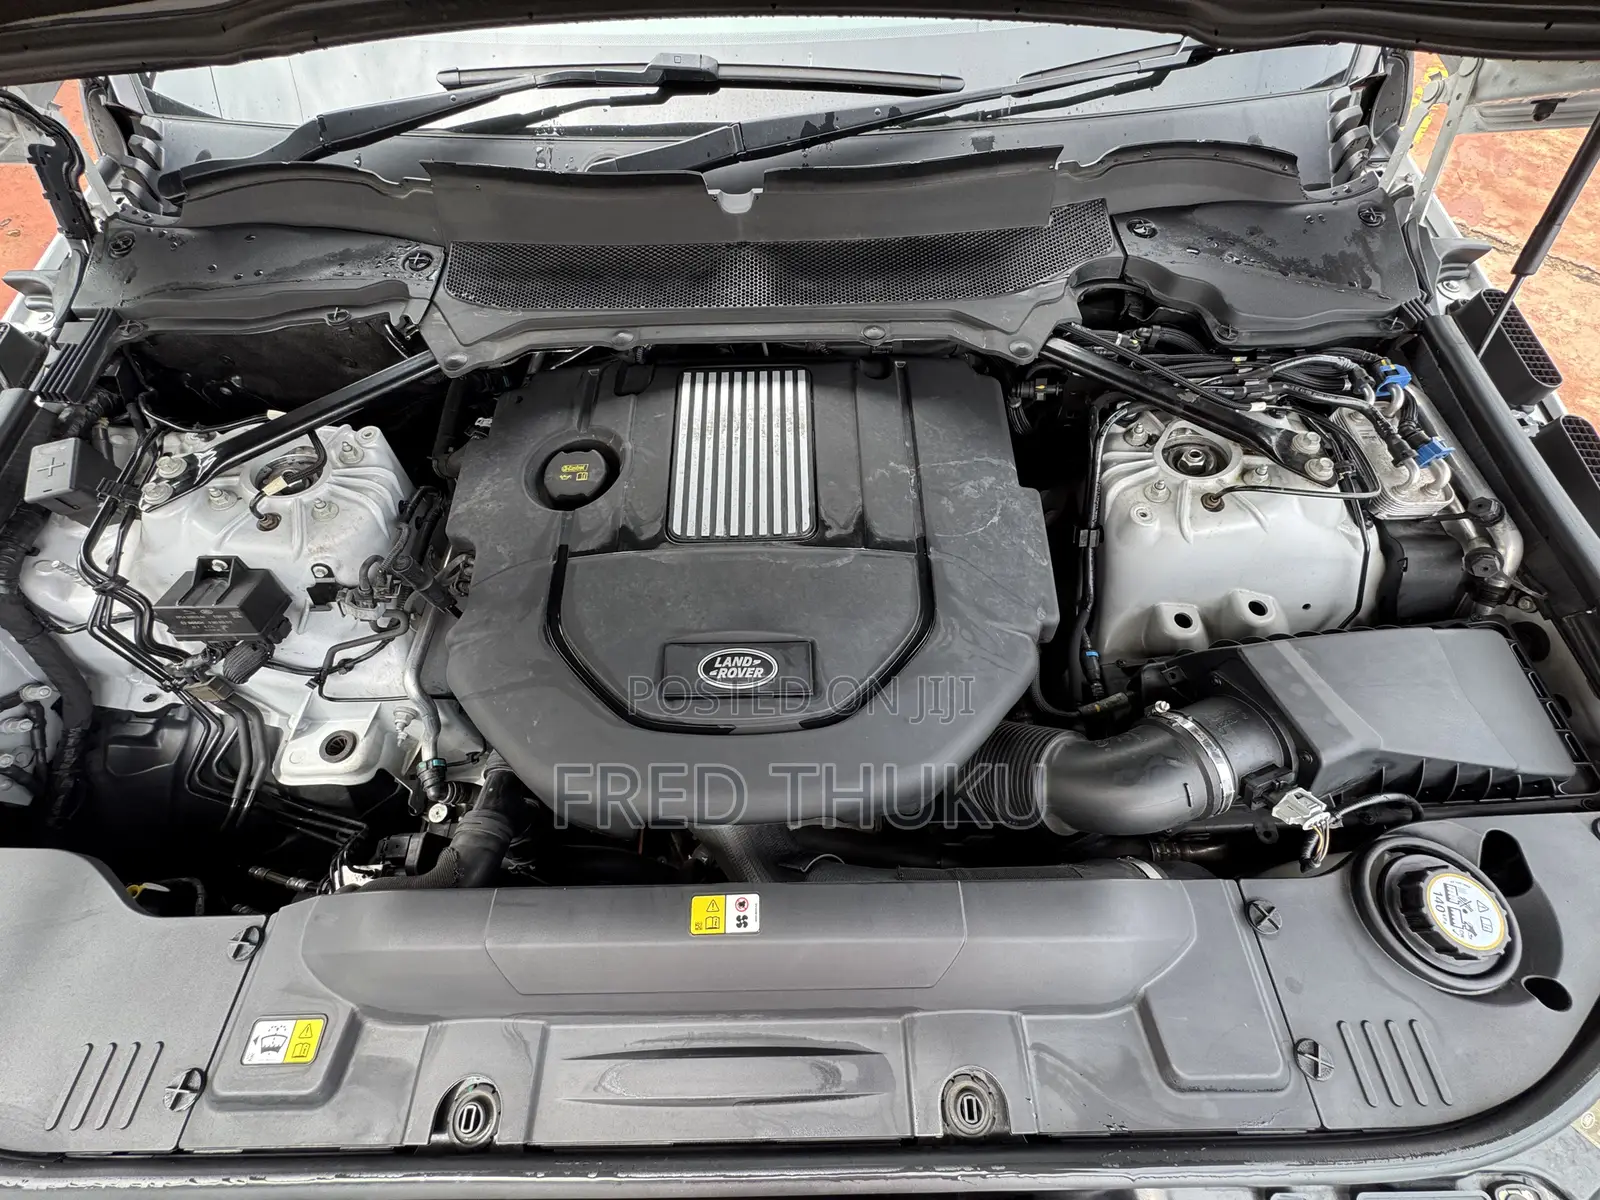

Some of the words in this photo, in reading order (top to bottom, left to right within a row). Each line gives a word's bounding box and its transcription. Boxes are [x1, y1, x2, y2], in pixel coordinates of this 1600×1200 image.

[714, 656, 753, 668] LAND
[717, 667, 764, 678] ROVER
[1433, 891, 1446, 914] 140
